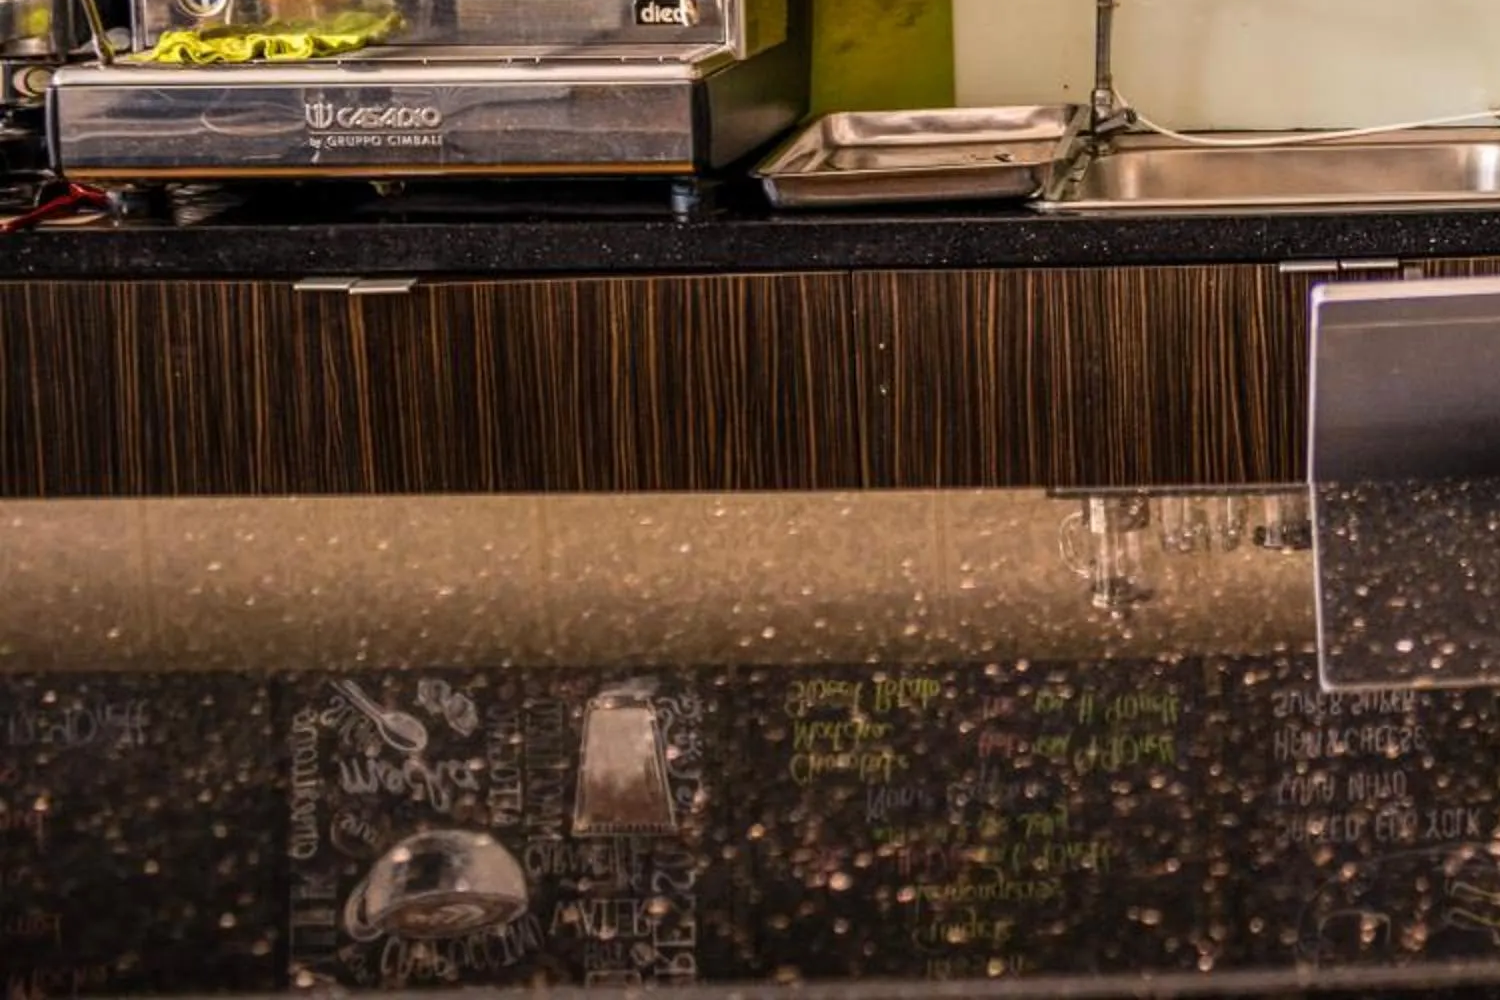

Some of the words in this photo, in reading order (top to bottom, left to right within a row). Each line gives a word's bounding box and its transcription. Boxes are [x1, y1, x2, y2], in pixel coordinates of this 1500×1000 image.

[336, 105, 443, 129] CASADIO
[326, 135, 383, 147] GRUPPO
[387, 134, 443, 147] CIMBALI
